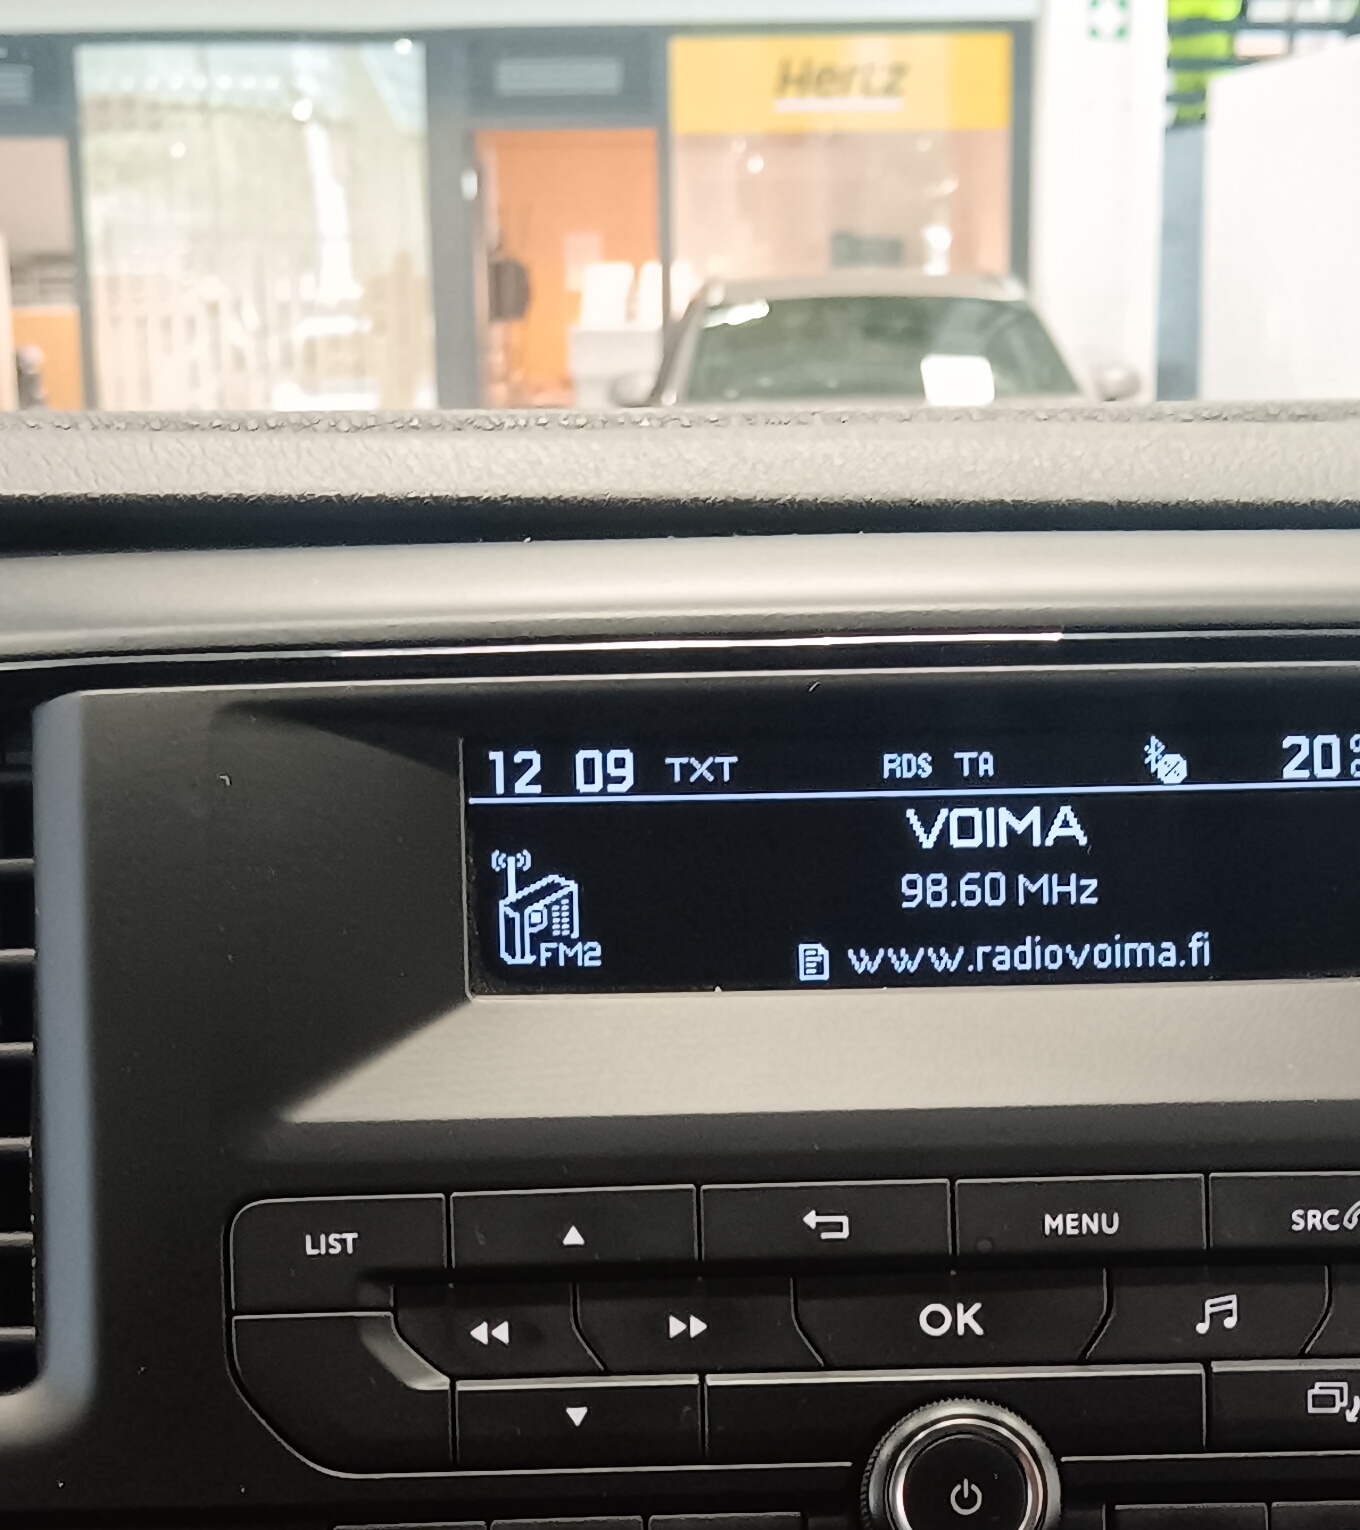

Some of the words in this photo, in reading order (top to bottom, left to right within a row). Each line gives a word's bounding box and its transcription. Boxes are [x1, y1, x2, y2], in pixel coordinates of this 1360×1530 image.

[772, 55, 913, 100] Hertz
[488, 749, 542, 796] 12
[575, 748, 635, 792] 09
[664, 755, 739, 783] TXT
[883, 752, 933, 779] RDS
[953, 751, 995, 778] TA
[905, 804, 1088, 850] VOIMA
[901, 871, 1007, 909] 98.60
[1017, 872, 1099, 907] MHz
[539, 941, 602, 967] FM2
[846, 930, 1211, 976] www.radiovoima.fi
[1044, 1212, 1120, 1236] MENU
[1291, 1208, 1340, 1231] SRC
[305, 1232, 359, 1256] LIST
[918, 1302, 984, 1337] OK
